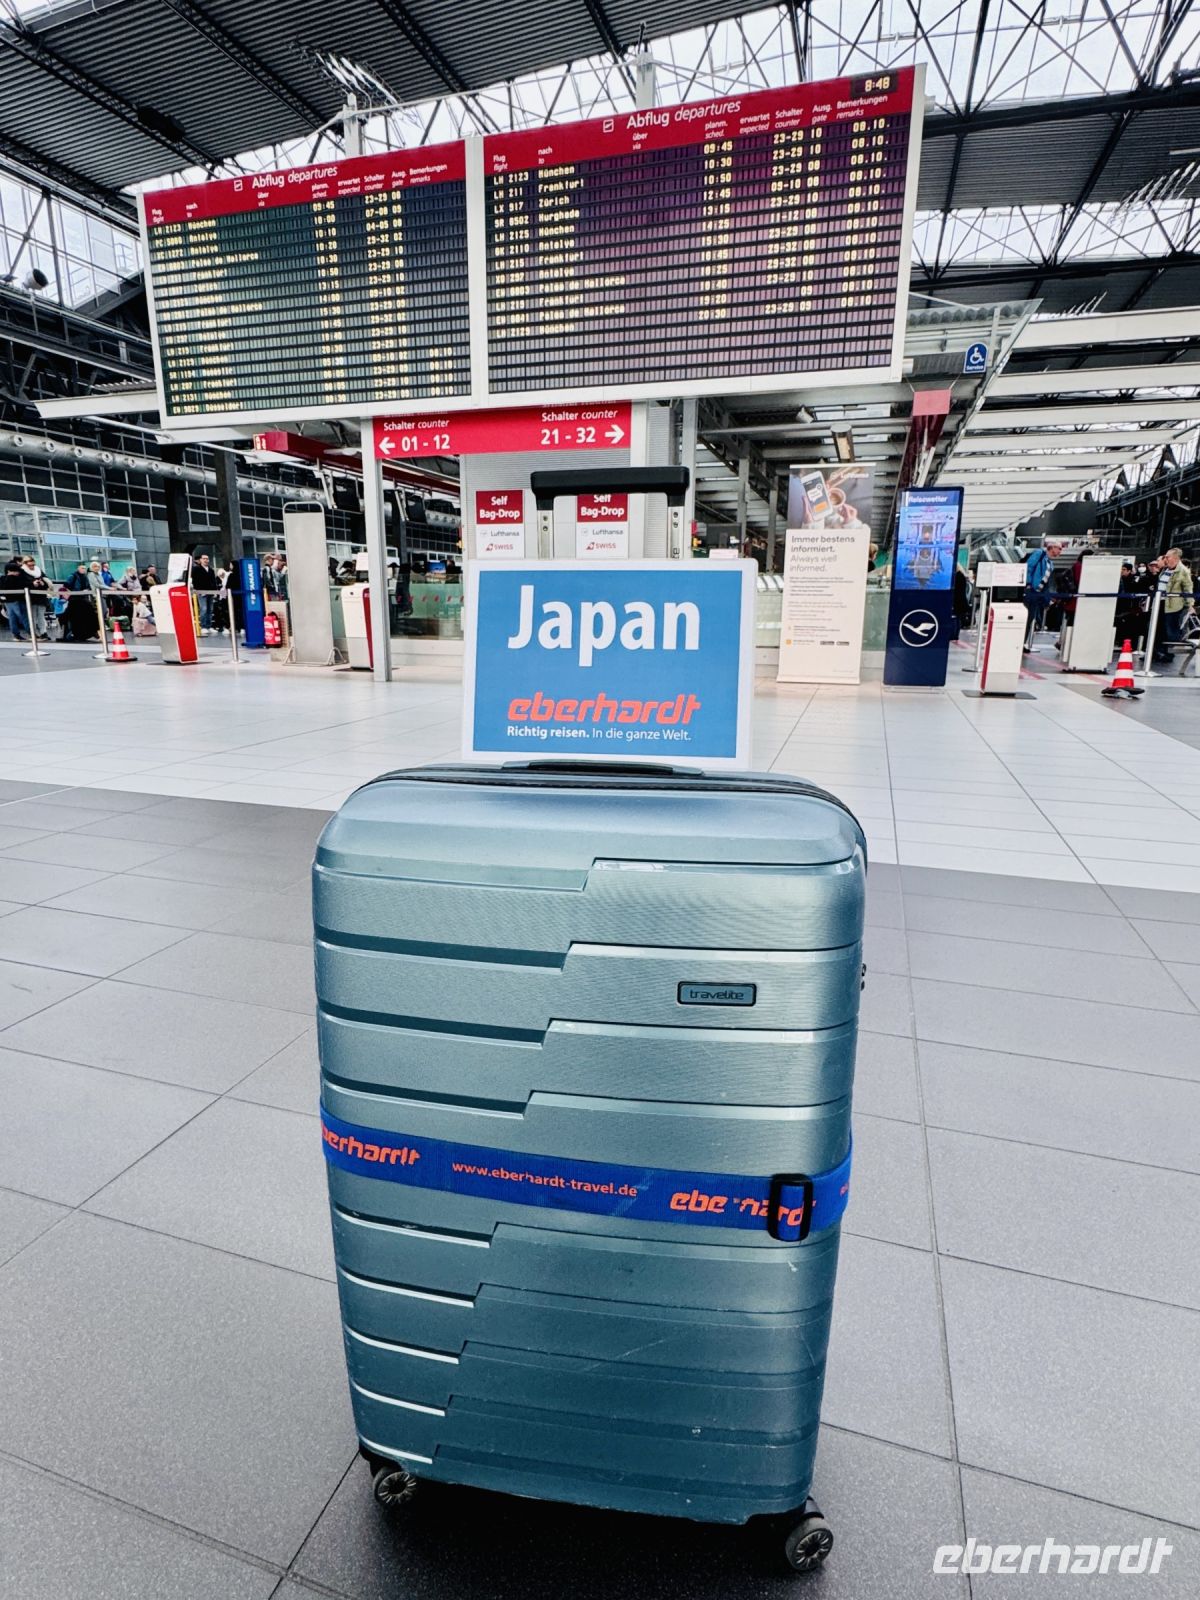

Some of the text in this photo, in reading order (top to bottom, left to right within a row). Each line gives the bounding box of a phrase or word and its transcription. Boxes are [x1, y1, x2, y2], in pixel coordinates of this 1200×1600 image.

[865, 76, 890, 91] 8:48
[626, 100, 741, 130] Abflug departures
[705, 130, 724, 139] sched.
[740, 122, 769, 135] expected
[775, 118, 800, 128] counter
[812, 114, 828, 124] gate
[836, 109, 864, 119] remarks
[538, 146, 552, 155] nach
[632, 131, 648, 142] über
[705, 119, 727, 130] planm.
[740, 112, 770, 124] erwartet
[775, 107, 803, 119] Schalter
[812, 104, 832, 113] Ausg.
[837, 95, 888, 109] Bemerkungen
[509, 172, 528, 183] 2123
[539, 166, 574, 178] München
[704, 141, 732, 153] 09:45
[774, 130, 804, 144] 23-29
[811, 127, 822, 138] 10
[252, 168, 337, 189] Abflug departures
[338, 177, 360, 186] erwartet
[364, 174, 384, 182] Schalter
[410, 164, 447, 175] Bemerkungen
[509, 188, 522, 198] 211
[704, 157, 732, 169] 10:30
[773, 147, 802, 160] 23-29
[810, 144, 821, 154] 10
[338, 186, 360, 195] expected
[410, 176, 430, 184] remarks
[509, 202, 523, 211] 917
[539, 196, 569, 208] Zürich
[704, 173, 731, 184] 10:50
[772, 163, 801, 176] 23-29
[704, 188, 731, 200] 12:45
[771, 179, 800, 191] 09-10
[313, 201, 334, 211] 09:45
[510, 230, 529, 240] 2125
[703, 204, 730, 215] 13:15
[771, 194, 799, 206] 23-29
[806, 192, 818, 202] 10
[702, 219, 729, 230] 14:25
[770, 210, 798, 222] 11-12
[702, 235, 729, 246] 15:30
[769, 226, 798, 237] 23-29
[395, 246, 403, 254] 10
[768, 241, 797, 252] 29-32
[767, 256, 796, 268] 29-32
[767, 272, 795, 283] 23-29
[802, 270, 813, 281] 10
[765, 302, 794, 314] 23-29
[542, 409, 618, 422] Schalter counter
[383, 419, 450, 431] Schalter counter
[402, 436, 418, 451] 01
[433, 434, 450, 450] 12
[540, 429, 560, 445] 21
[576, 427, 596, 443] 32
[491, 496, 507, 506] Self
[479, 508, 520, 520] Bag-Drop
[581, 506, 624, 518] Bag-Drop
[790, 555, 818, 563] Always
[508, 584, 700, 667] Japan
[508, 692, 701, 724] eberhardt
[507, 726, 691, 742] Richtig reisen. In die ganze Welt.
[690, 989, 744, 1000] travelite
[452, 1162, 638, 1198] www.eberhardt-travel.de
